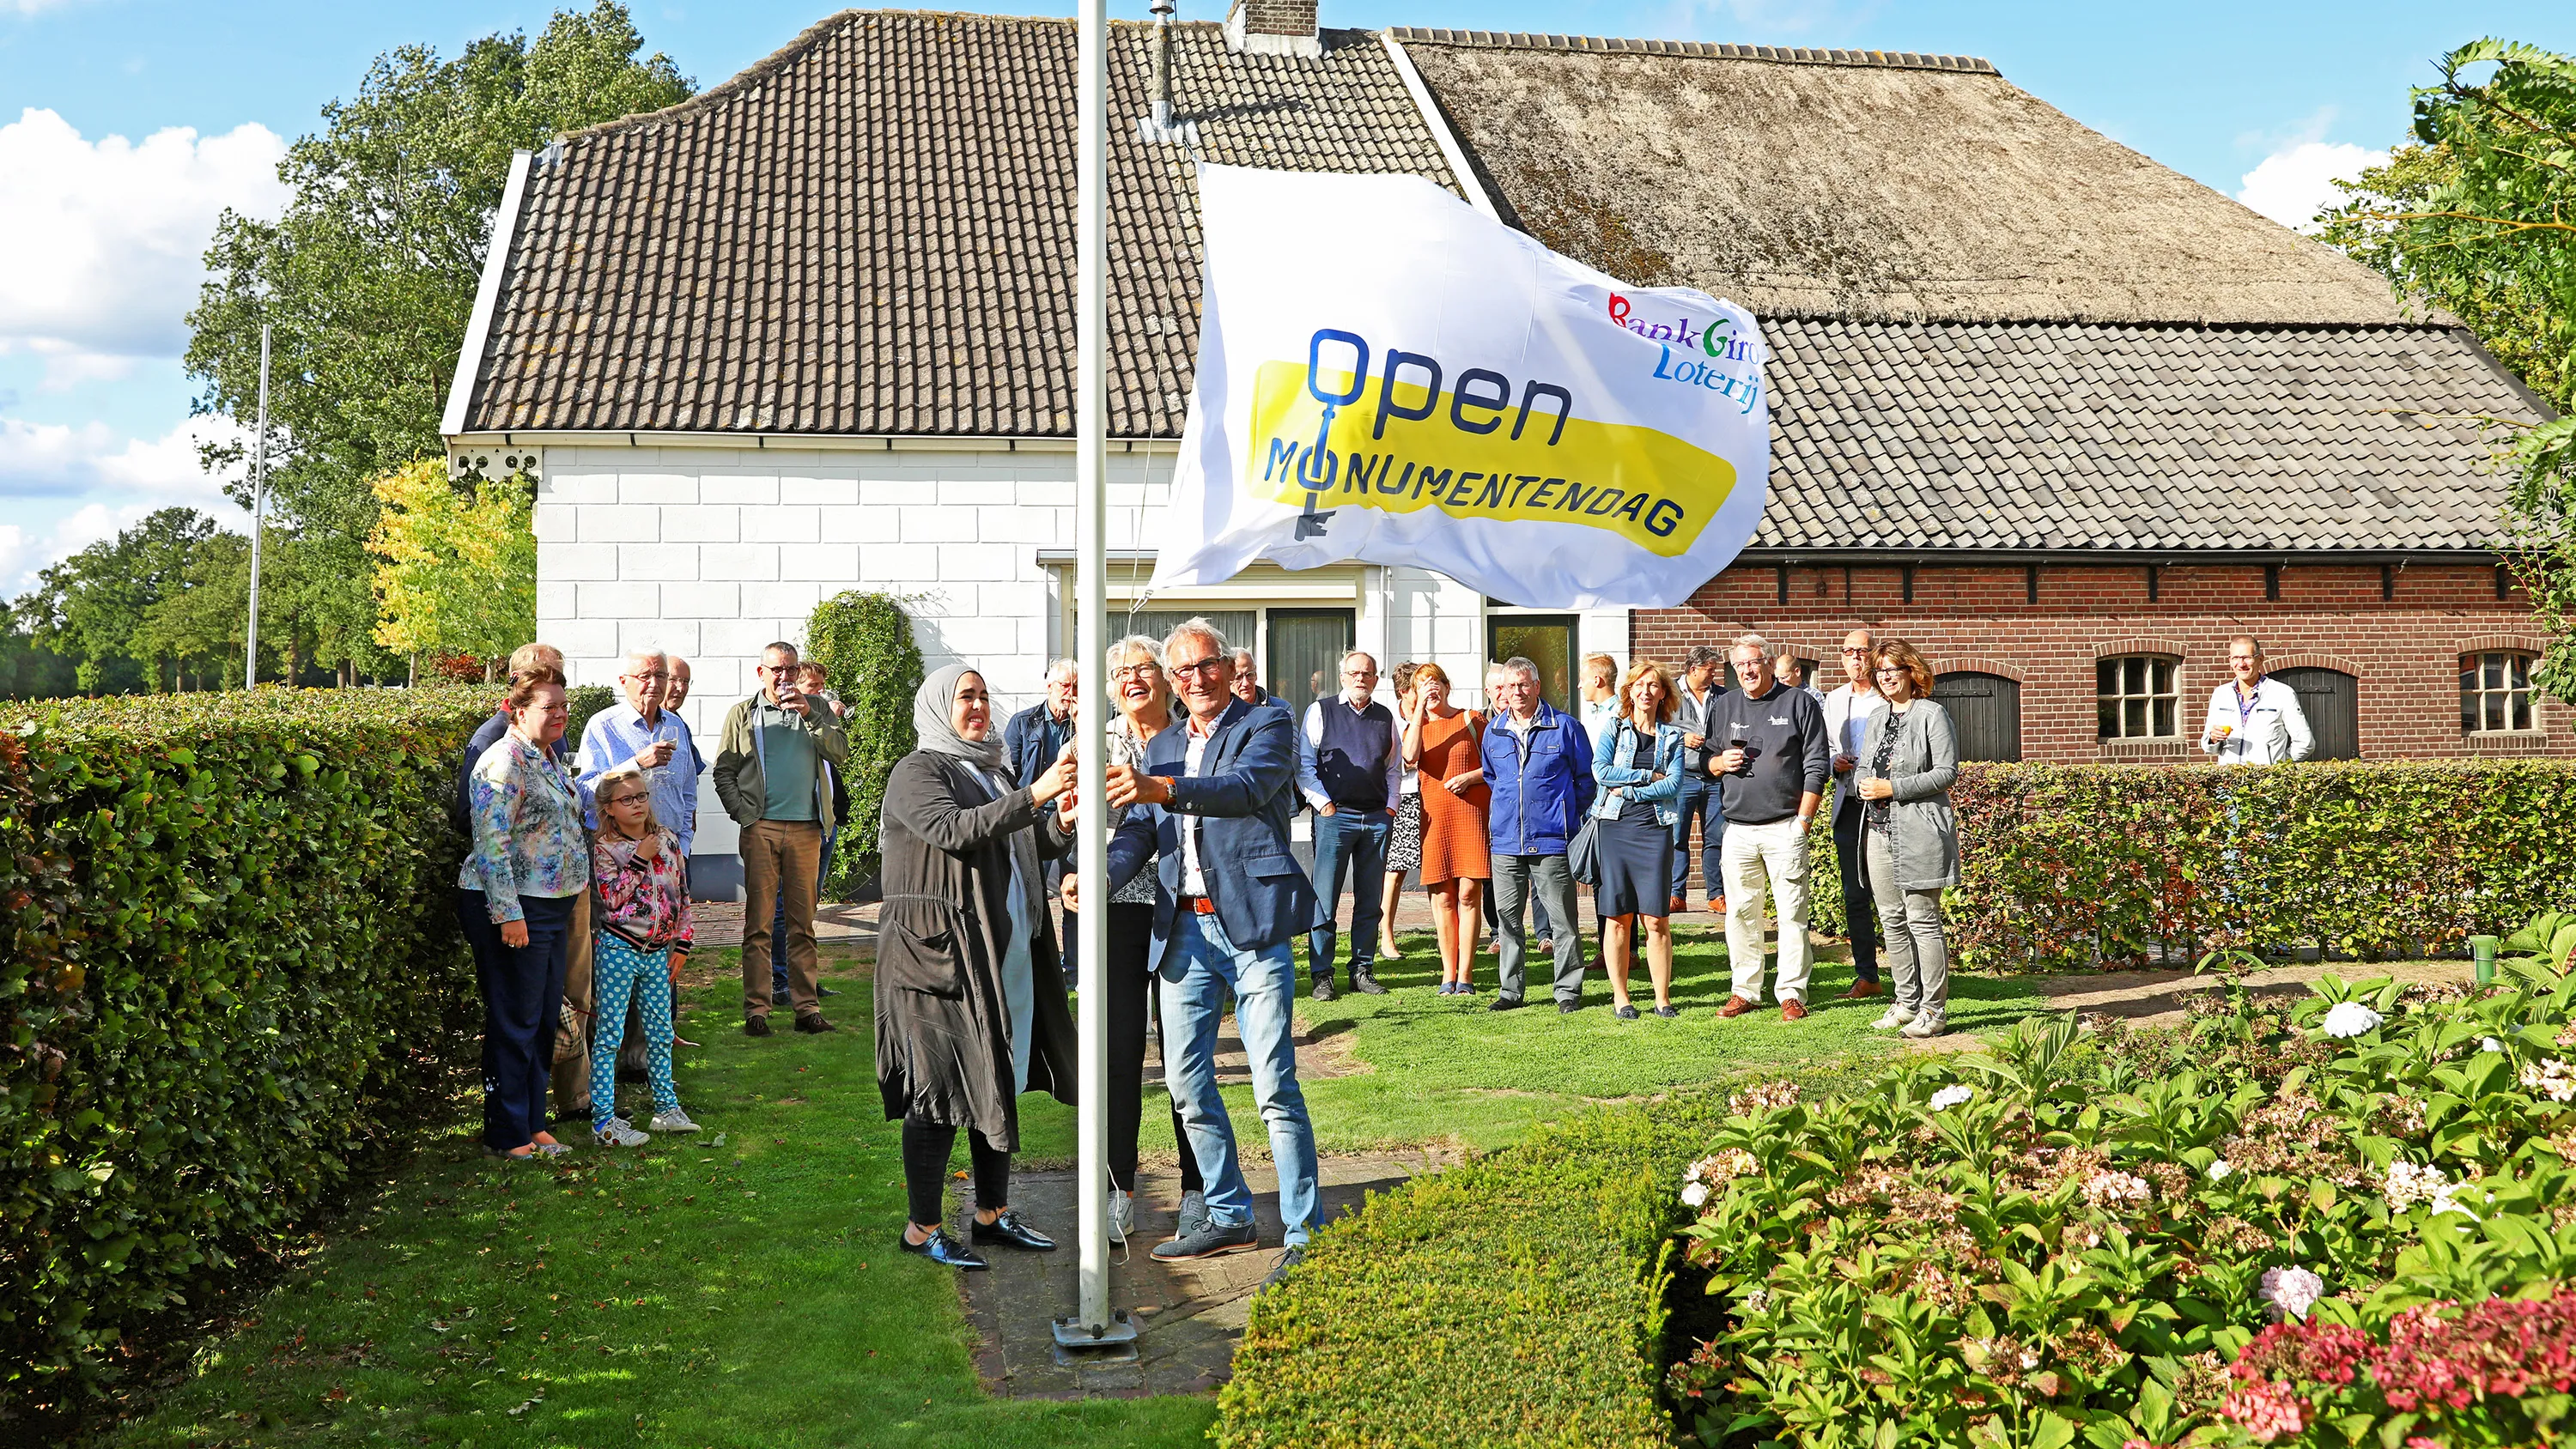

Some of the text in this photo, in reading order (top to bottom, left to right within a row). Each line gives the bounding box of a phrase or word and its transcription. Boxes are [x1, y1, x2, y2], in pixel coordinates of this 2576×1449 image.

[1608, 292, 1760, 365] BankGiro
[1653, 343, 1759, 415] Loterij
[1264, 437, 1685, 537] MONUMENTENDAG
